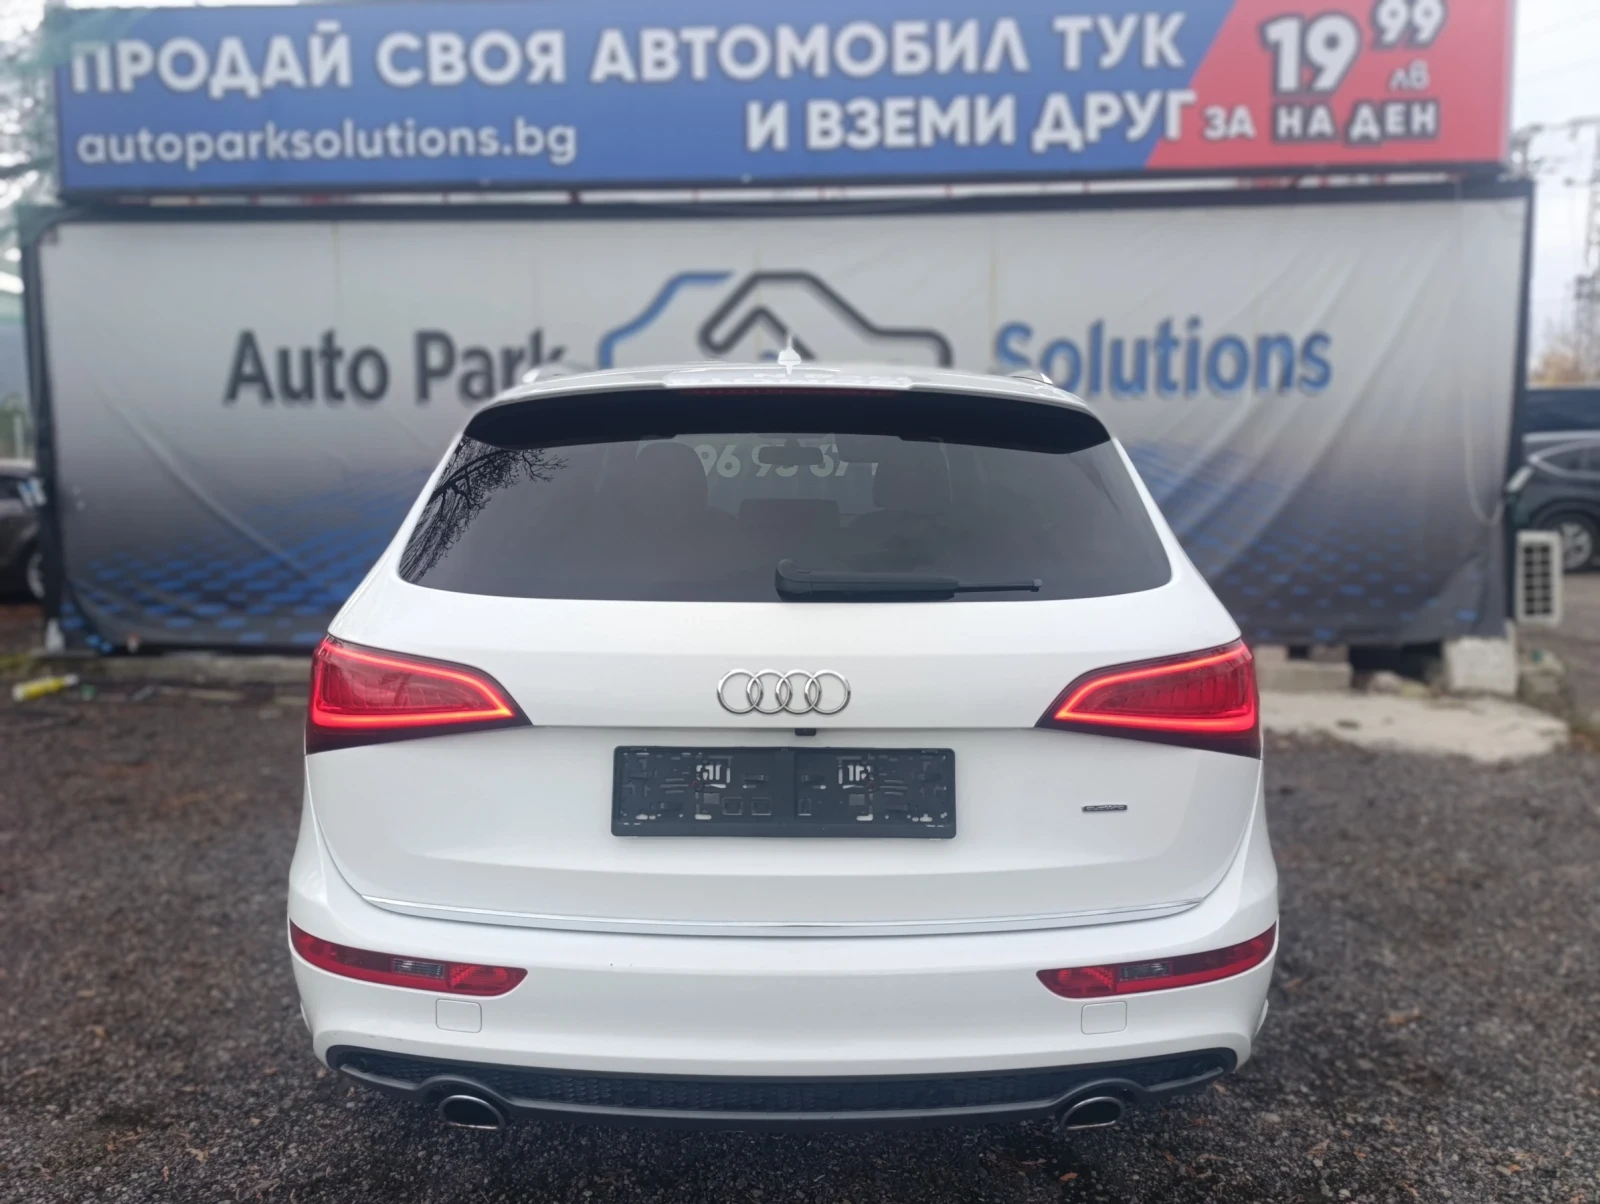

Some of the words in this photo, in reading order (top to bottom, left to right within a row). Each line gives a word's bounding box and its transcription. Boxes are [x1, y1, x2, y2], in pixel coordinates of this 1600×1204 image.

[70, 21, 353, 99] ПРОДАЙ
[375, 29, 566, 86] СВОЯ
[589, 17, 1031, 83] АВТОМОБИЛ
[1053, 11, 1186, 70] ТУК
[1264, 13, 1361, 92] 19
[1375, 0, 1445, 45] 99
[1389, 60, 1430, 91] лв
[76, 116, 578, 171] autoparksolutions.bg
[746, 100, 789, 151] И
[806, 94, 1017, 150] ВЗЕМИ
[1030, 90, 1197, 153] ДРУГ
[1203, 106, 1257, 140] ЗА
[1276, 103, 1335, 139] НА
[1348, 102, 1438, 141] ДЕН
[223, 328, 391, 405] Auto
[991, 315, 1332, 398] Solutions
